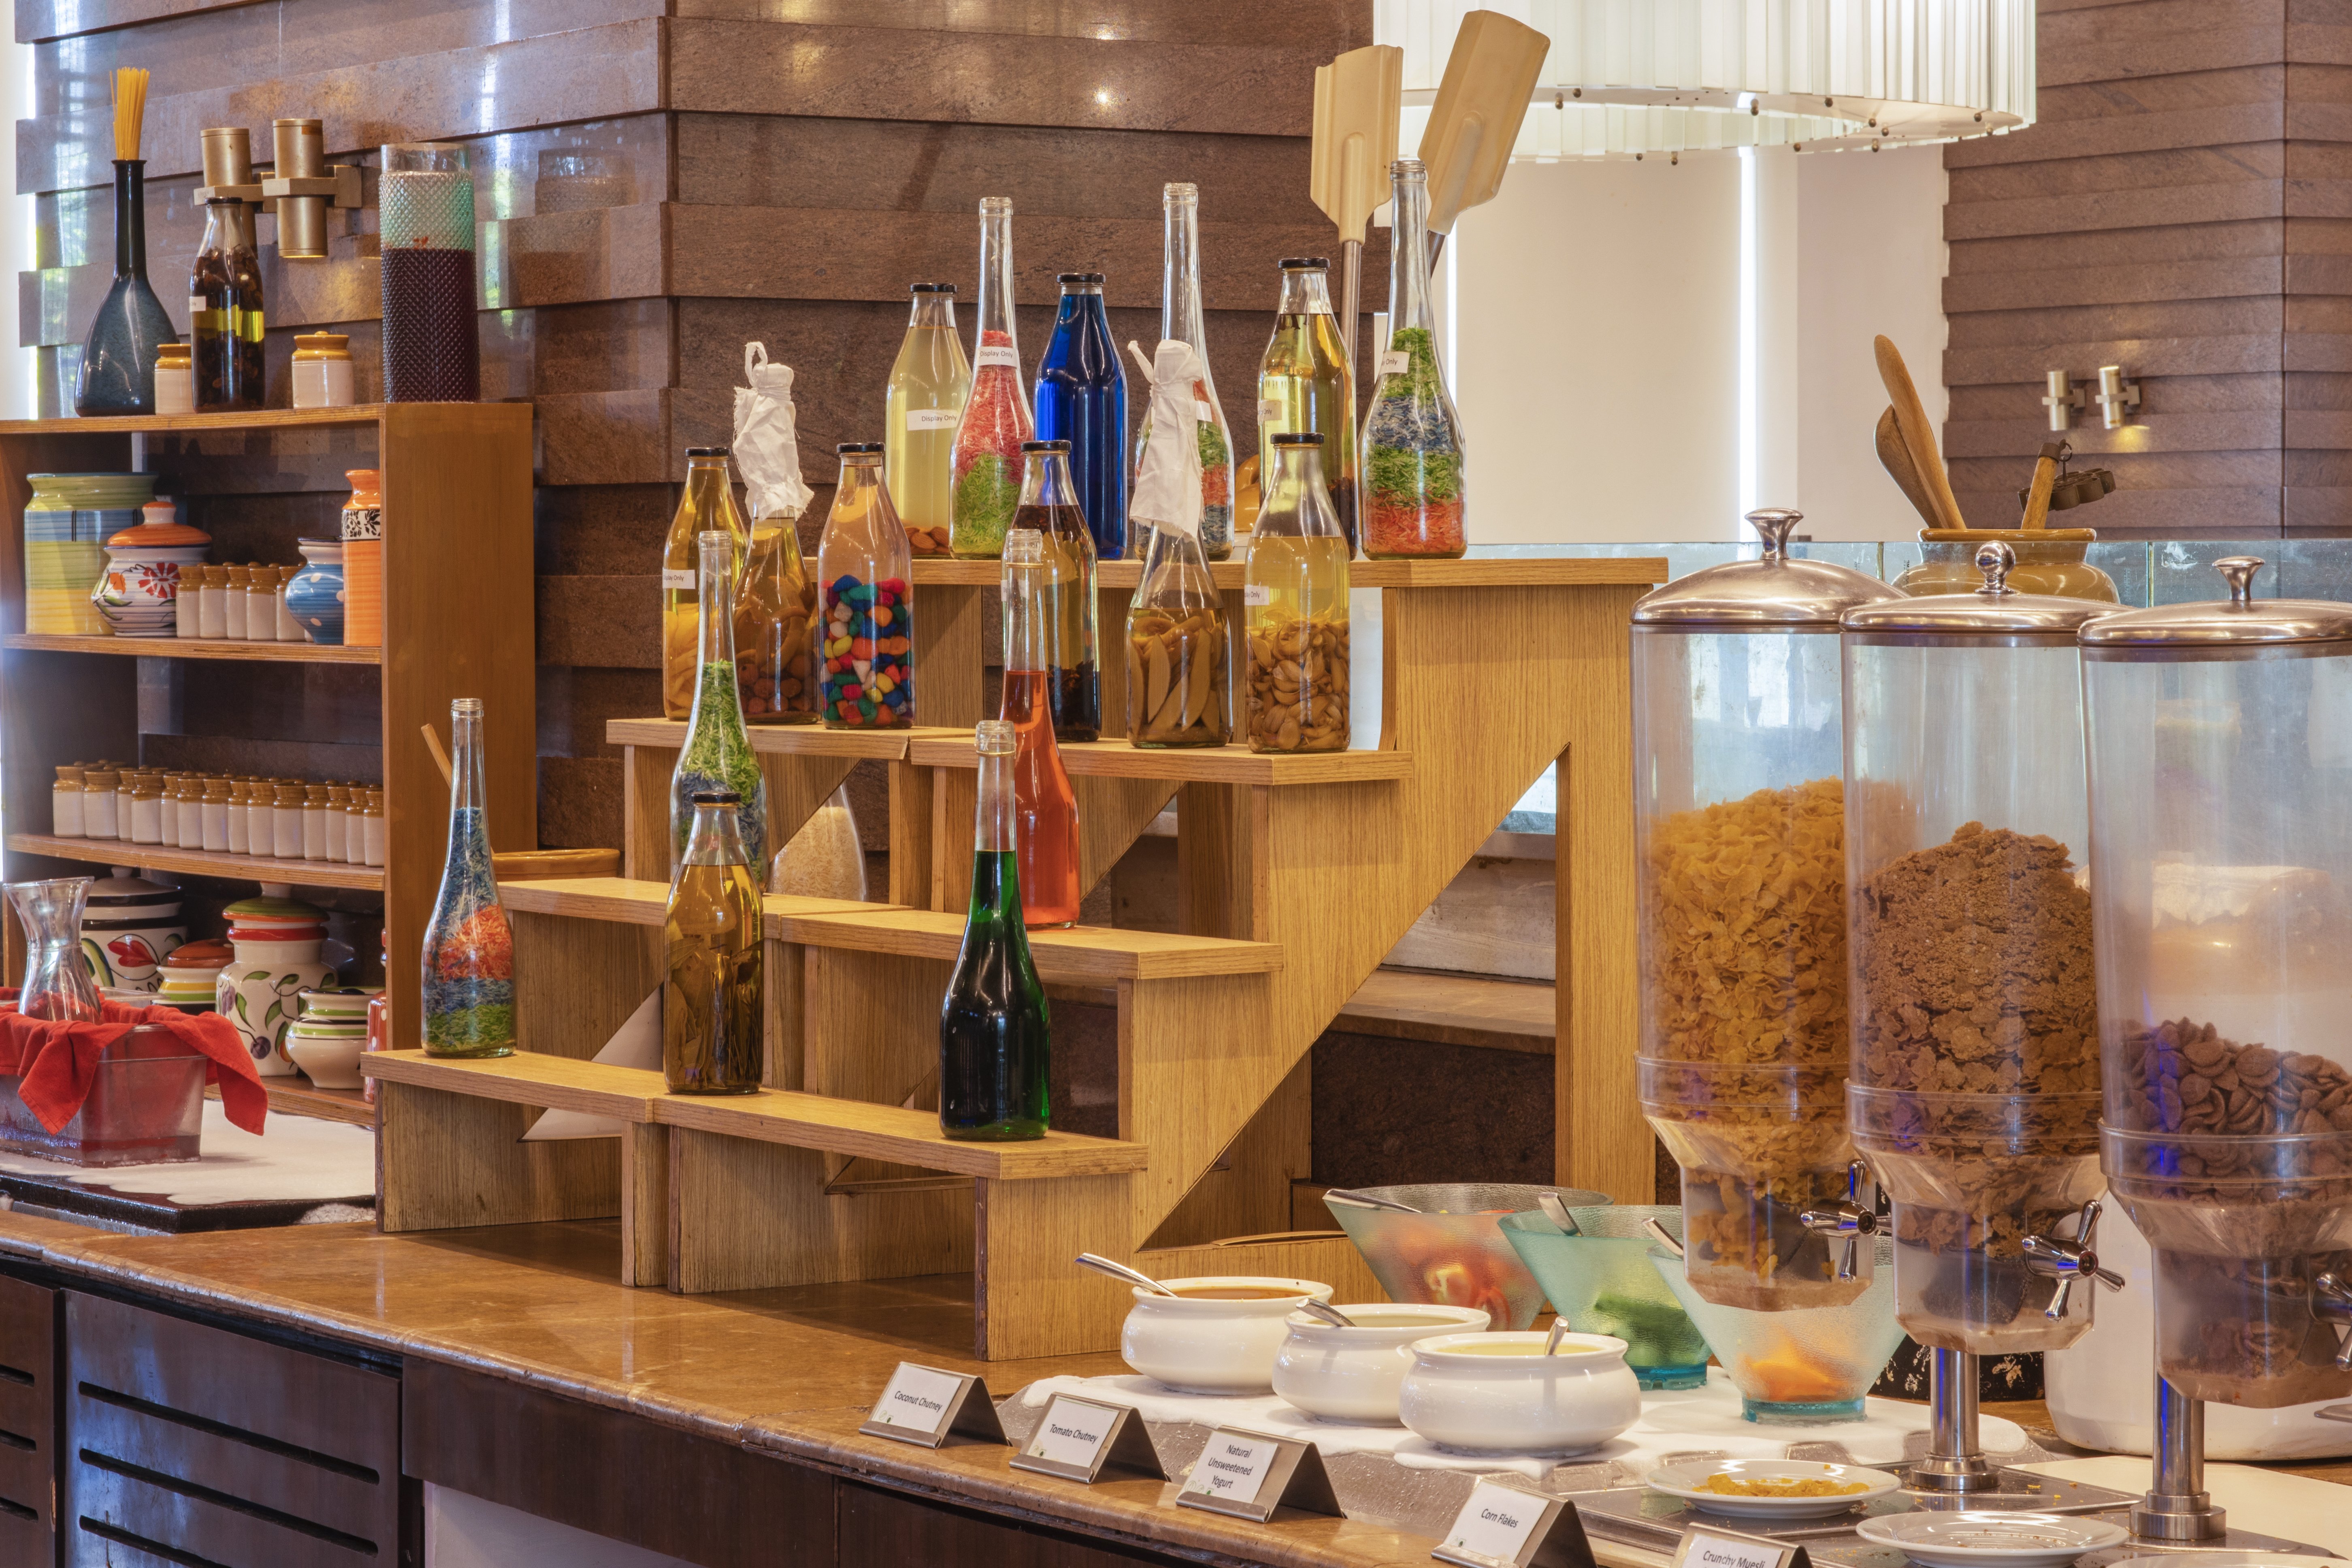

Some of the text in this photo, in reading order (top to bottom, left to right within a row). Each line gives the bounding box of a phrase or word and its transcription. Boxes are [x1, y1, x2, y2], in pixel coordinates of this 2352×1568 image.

[1001, 351, 1013, 359] Only
[1386, 358, 1398, 366] Only
[894, 1391, 943, 1413] Coconut Chutney
[1050, 1424, 1098, 1444] Tomato Chutney
[1226, 1444, 1253, 1458] Natural
[1208, 1457, 1254, 1476] Unsweetened
[1211, 1475, 1234, 1489] Yogurt
[1481, 1508, 1519, 1528] Corn Flakes
[1703, 1550, 1766, 1568] Crunchy Muesli
